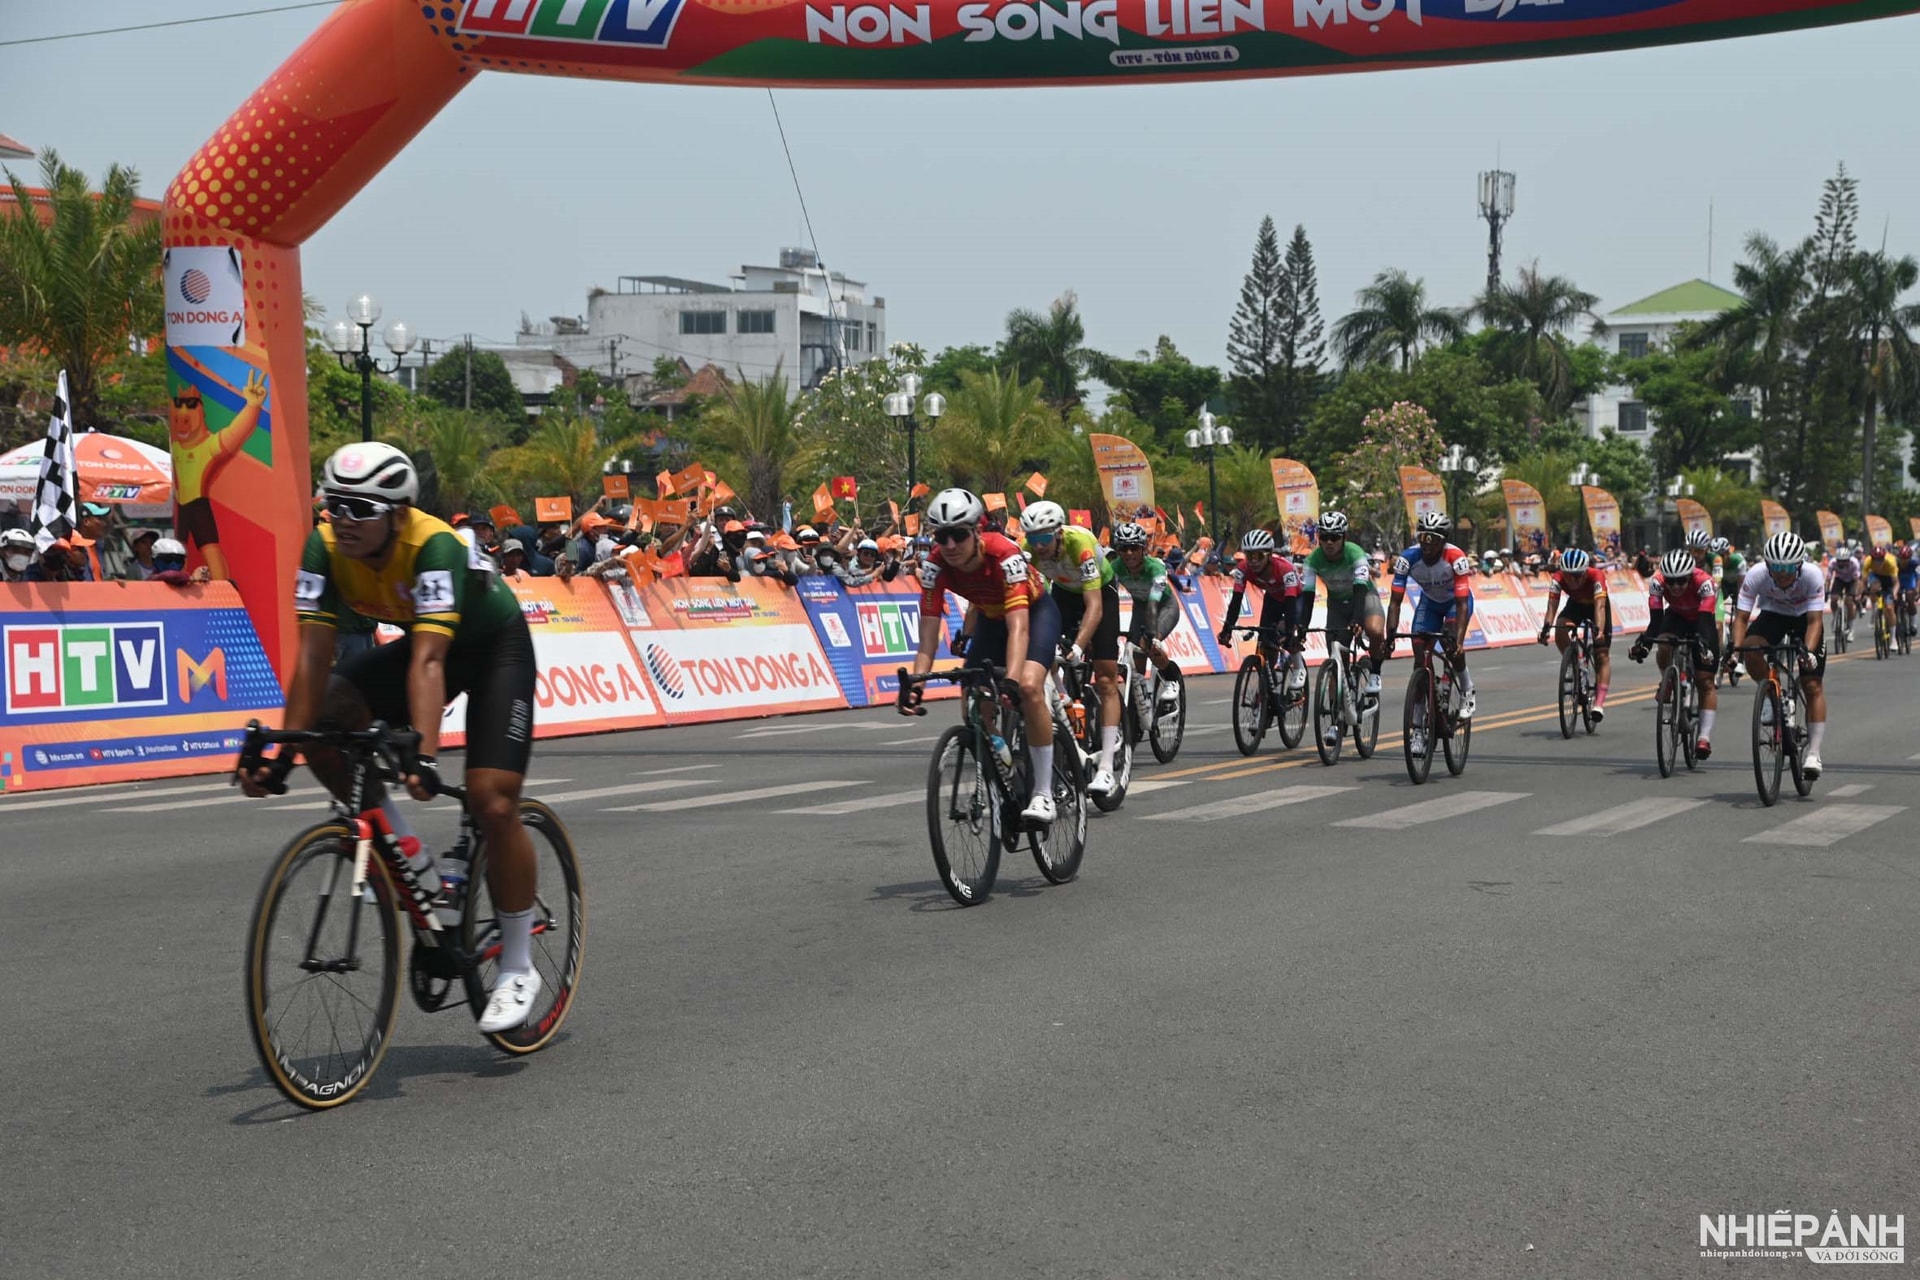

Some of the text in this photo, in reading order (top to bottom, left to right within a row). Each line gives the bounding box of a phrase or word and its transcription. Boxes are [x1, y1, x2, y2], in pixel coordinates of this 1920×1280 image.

[805, 3, 932, 44] NON
[1116, 54, 1142, 65] HTV
[167, 311, 243, 325] TON DONG A
[0, 484, 14, 494] ON
[95, 485, 141, 498] HTV
[861, 611, 920, 647] HTV
[13, 638, 156, 696] HTV
[679, 652, 831, 696] TON DONG A
[534, 663, 646, 708] DONG A
